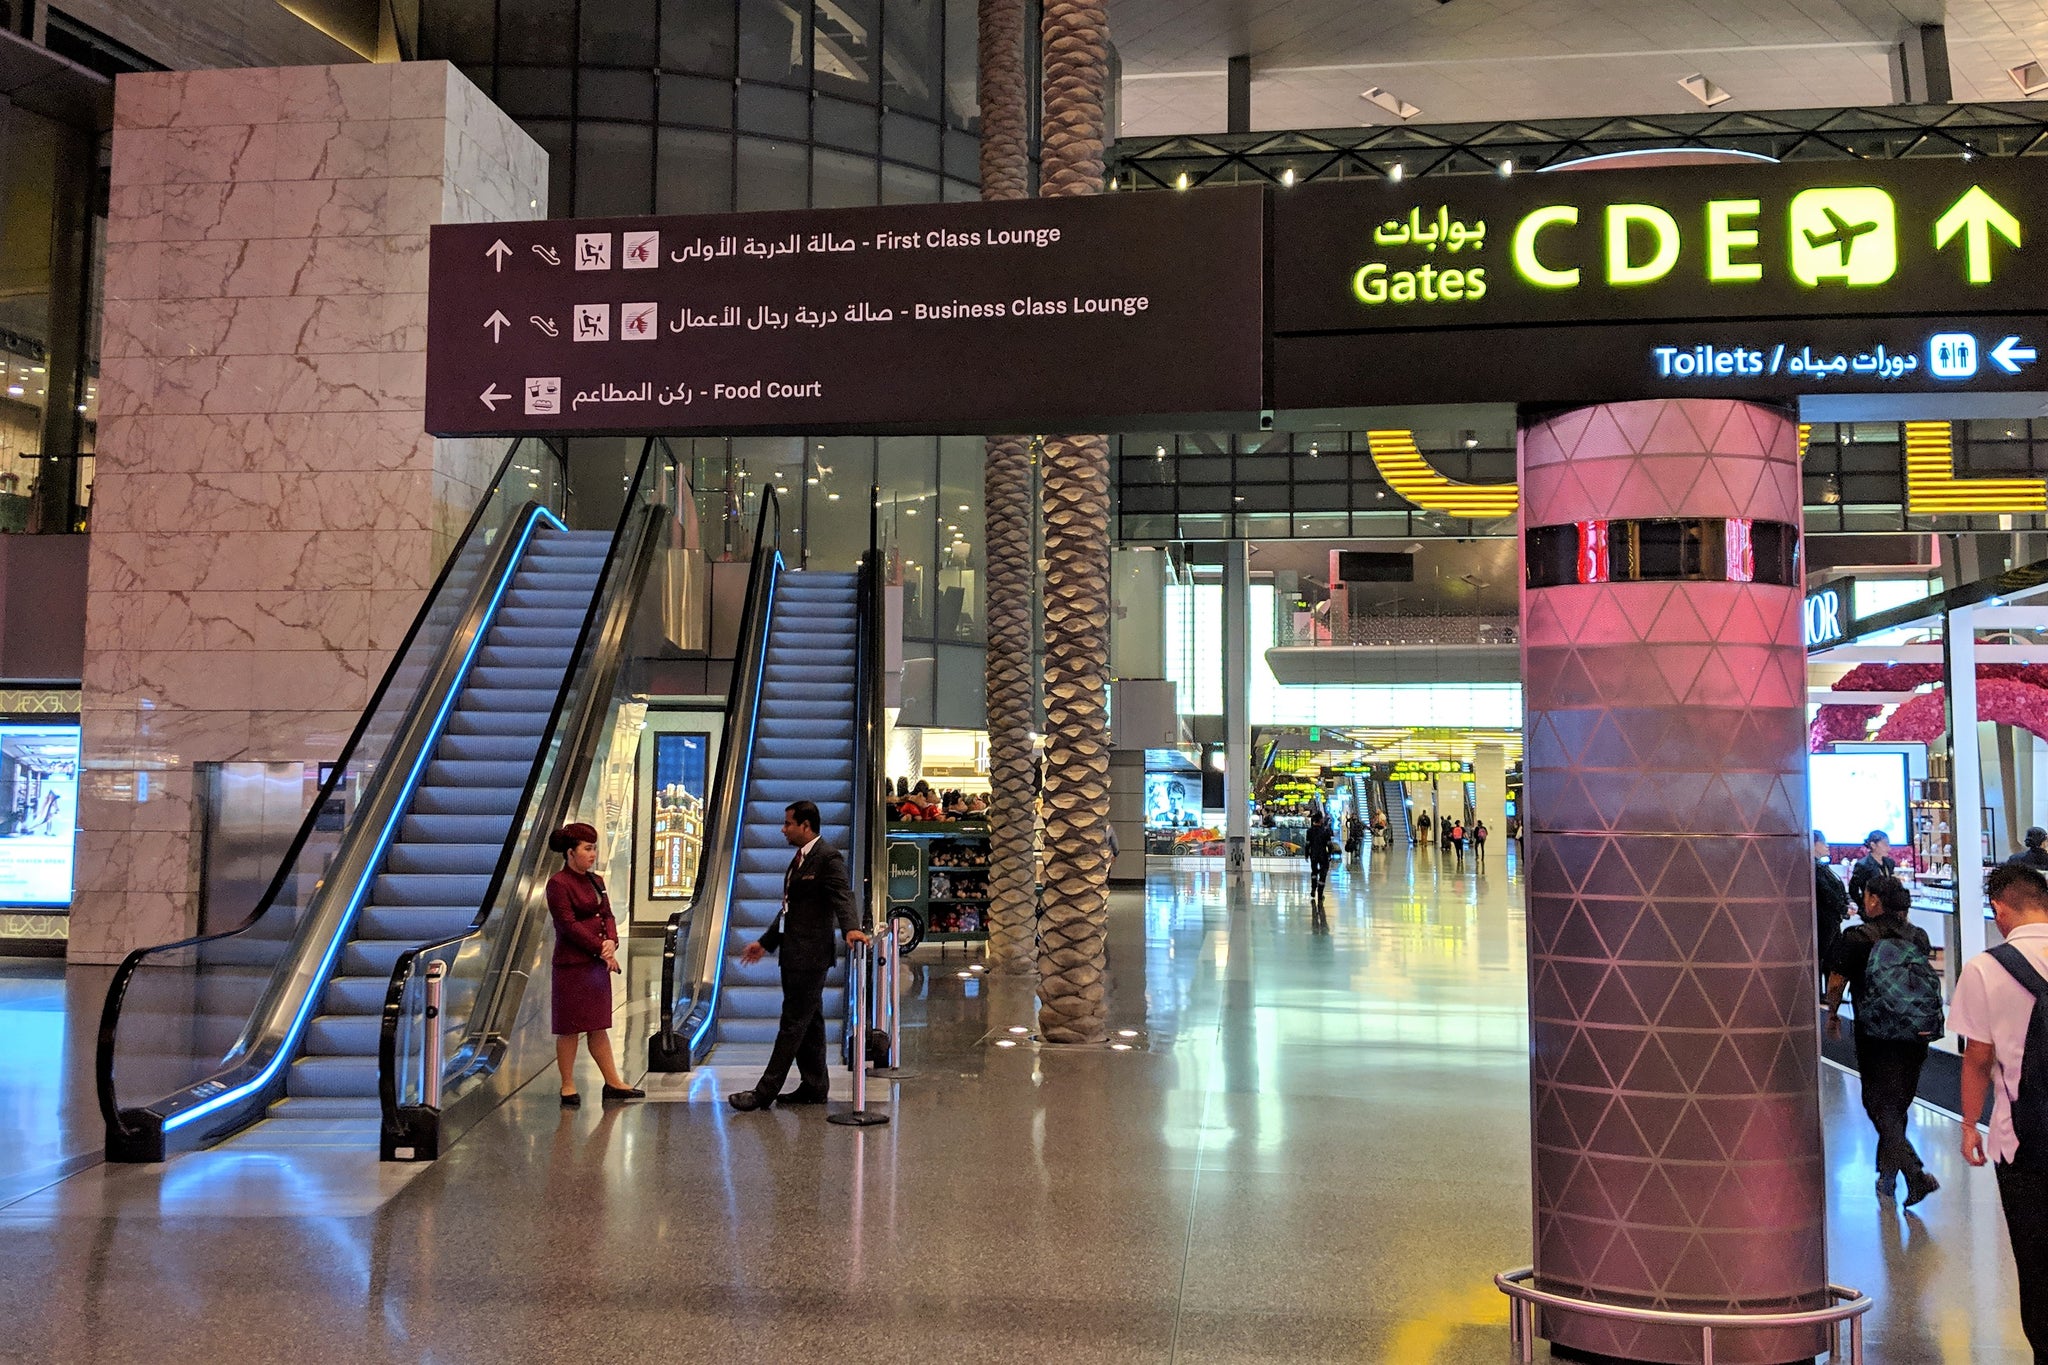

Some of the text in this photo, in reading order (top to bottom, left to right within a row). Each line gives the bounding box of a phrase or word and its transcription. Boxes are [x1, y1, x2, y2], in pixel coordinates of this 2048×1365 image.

[926, 228, 981, 248] Class
[987, 227, 1061, 249] Lounge
[1375, 205, 1486, 251] بوابات
[671, 235, 736, 262] الأولى
[743, 233, 801, 259] الدرجة
[807, 232, 856, 253] صالة
[876, 230, 921, 250] First
[1511, 199, 1763, 288] C D E
[1353, 263, 1487, 303] Gates
[794, 306, 838, 328] درجة
[844, 302, 893, 323] صالة
[915, 299, 1006, 320] Business
[1011, 296, 1067, 317] Class
[1073, 295, 1149, 317] Lounge
[669, 305, 741, 333] الأعمال
[747, 305, 789, 331] رجال
[1655, 344, 1918, 378] Toilets / دورات مياه
[572, 382, 652, 412] المطاعم
[658, 382, 692, 407] ركن
[714, 380, 761, 399] Food
[767, 379, 822, 398] Court
[1804, 590, 1842, 646] IOR
